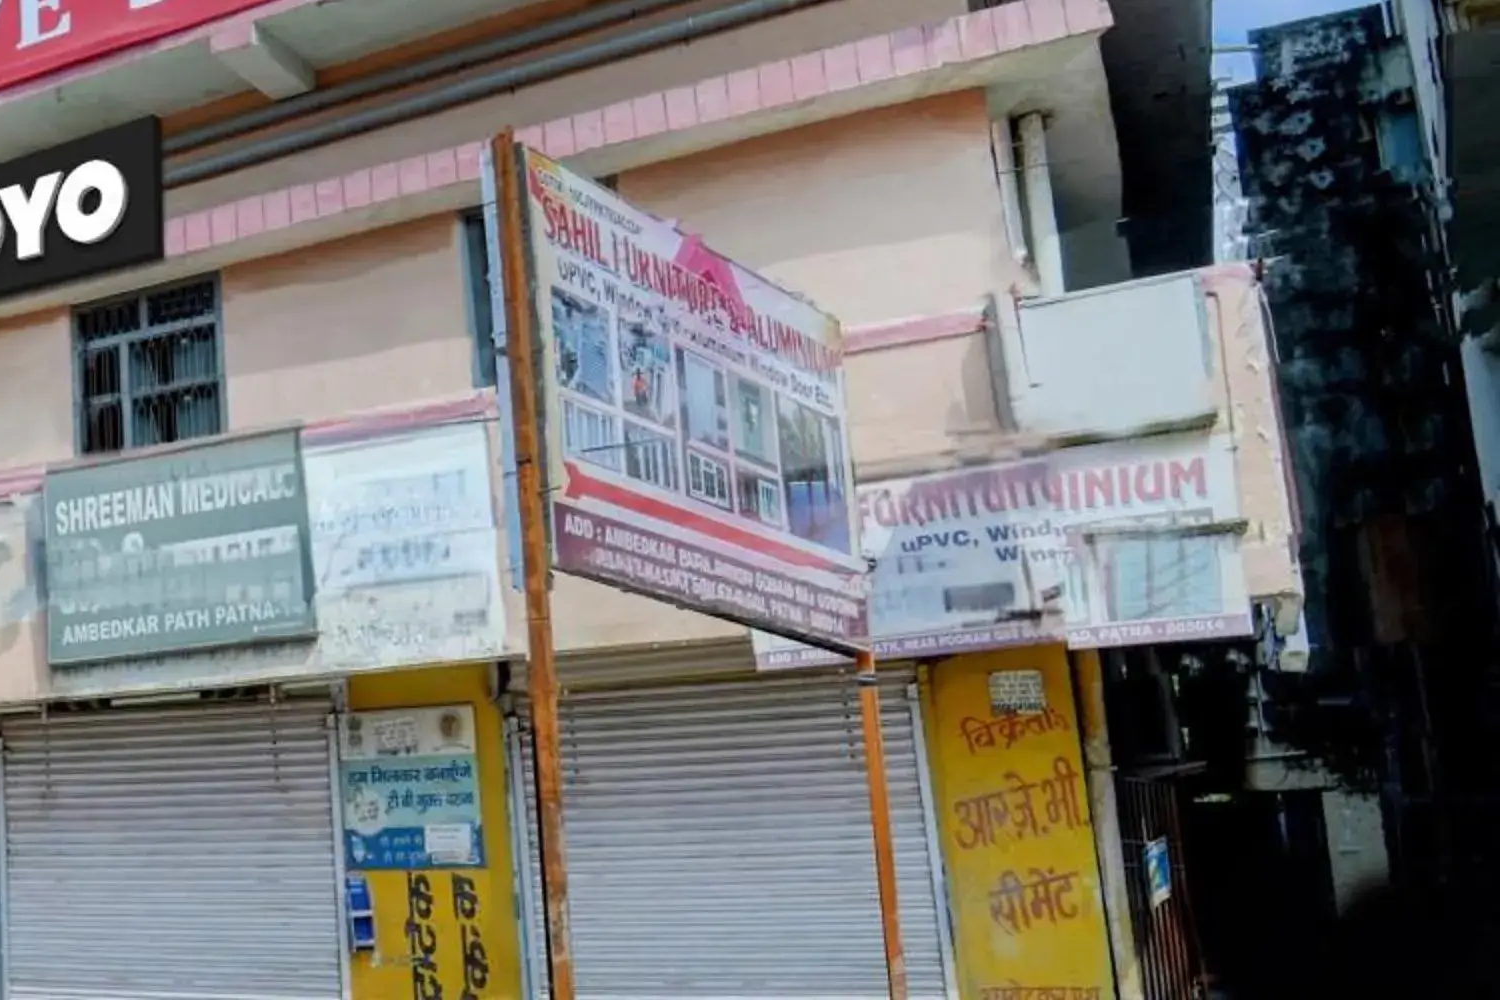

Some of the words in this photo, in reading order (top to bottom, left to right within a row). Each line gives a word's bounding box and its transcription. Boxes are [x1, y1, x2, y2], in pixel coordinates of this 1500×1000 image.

[543, 194, 608, 268] SAHIL
[56, 481, 175, 535] SHREEMAN
[62, 615, 159, 646] AMBEDKAR
[164, 609, 211, 633] PATH
